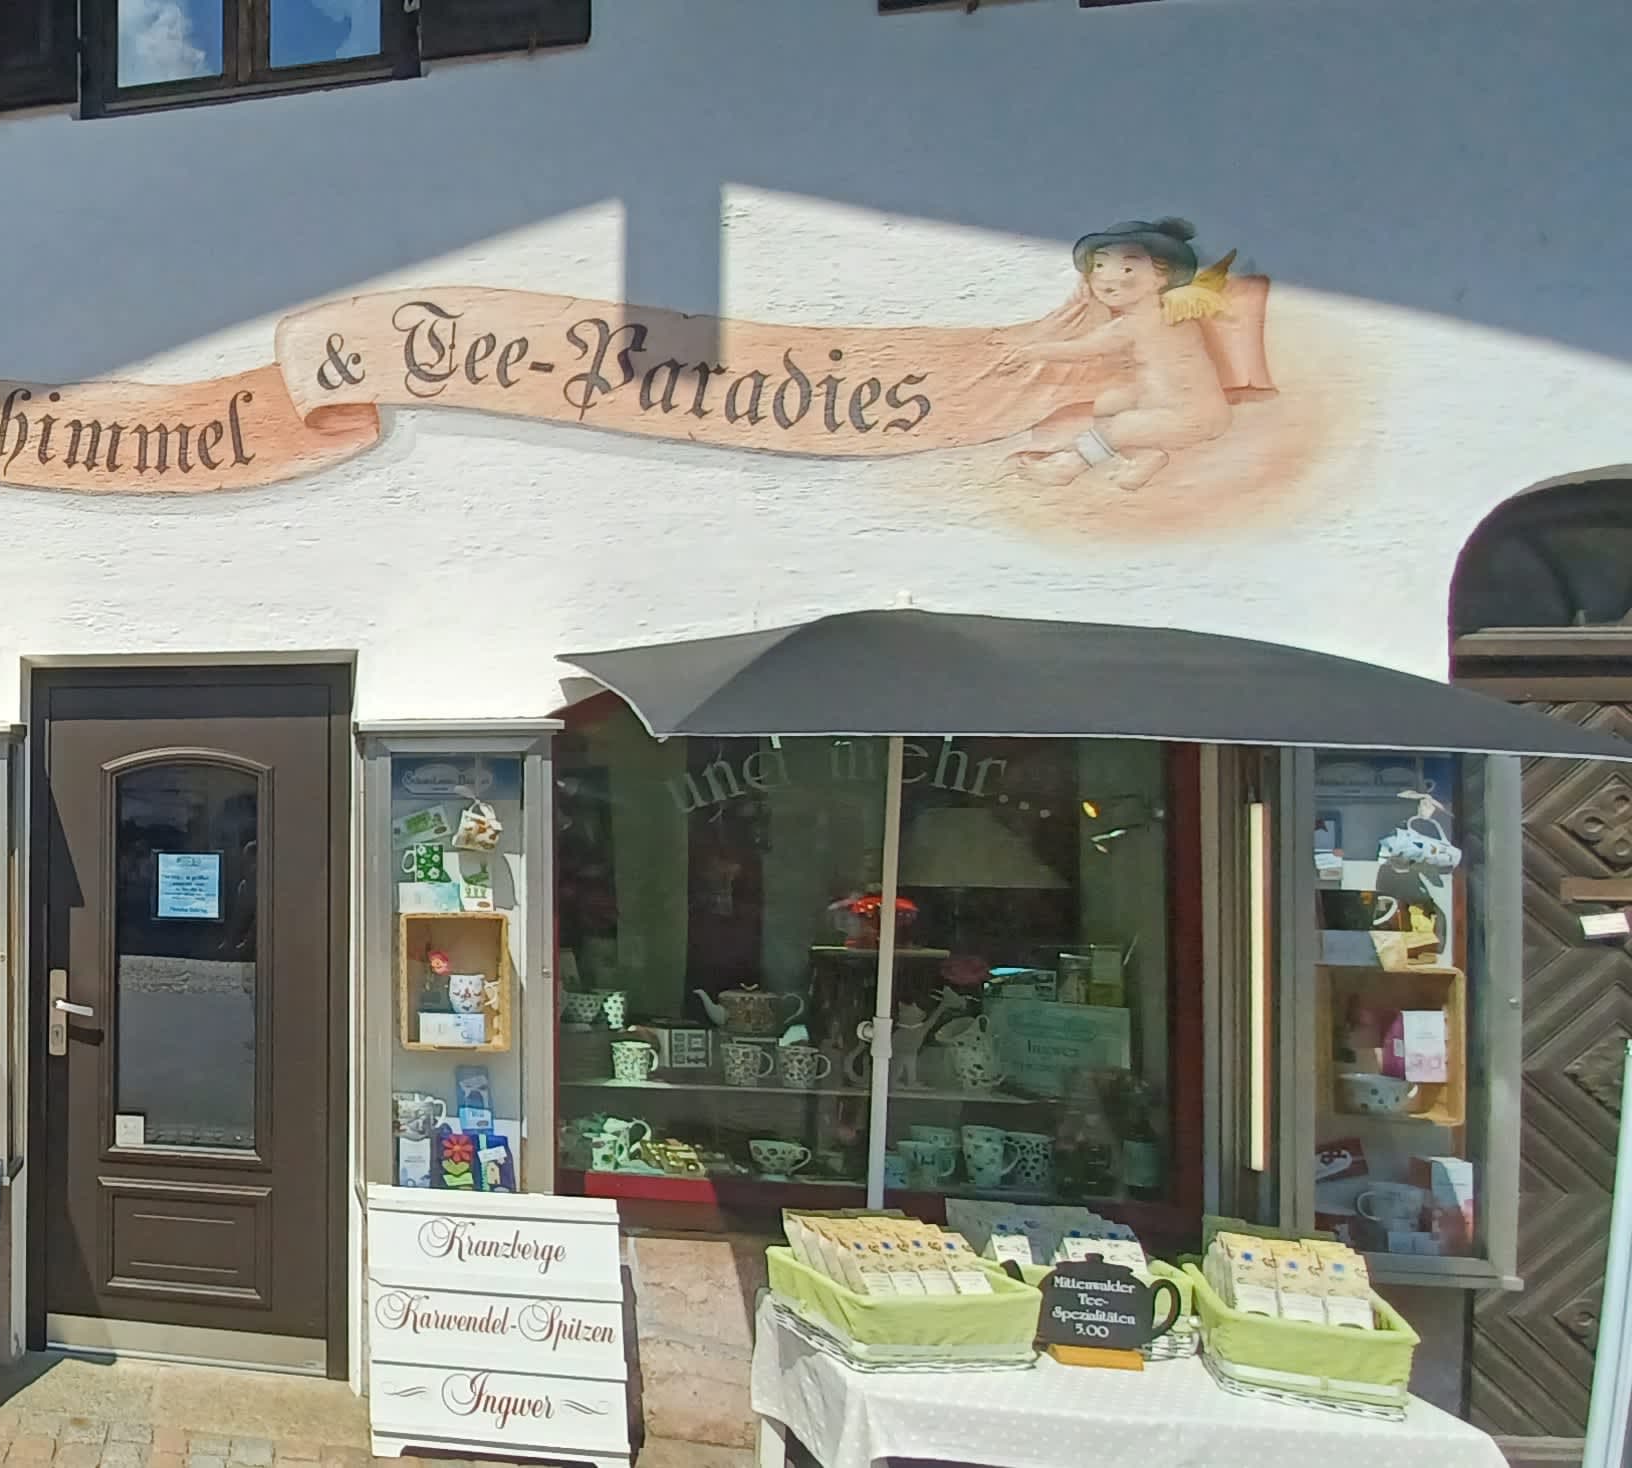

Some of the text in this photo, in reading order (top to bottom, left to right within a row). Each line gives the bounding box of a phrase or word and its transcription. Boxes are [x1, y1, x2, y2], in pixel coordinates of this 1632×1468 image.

[317, 333, 366, 391] &
[391, 301, 932, 433] Tee-Paradies
[669, 737, 790, 815] und
[418, 1216, 566, 1274] Kranzberge
[1054, 1275, 1137, 1294] Mittenwalder
[1078, 1293, 1109, 1307] Tee-
[375, 1290, 616, 1351] Karwendel-Spitzen
[1052, 1306, 1137, 1325] Spezialitäten
[441, 1371, 554, 1429] Ingwer
